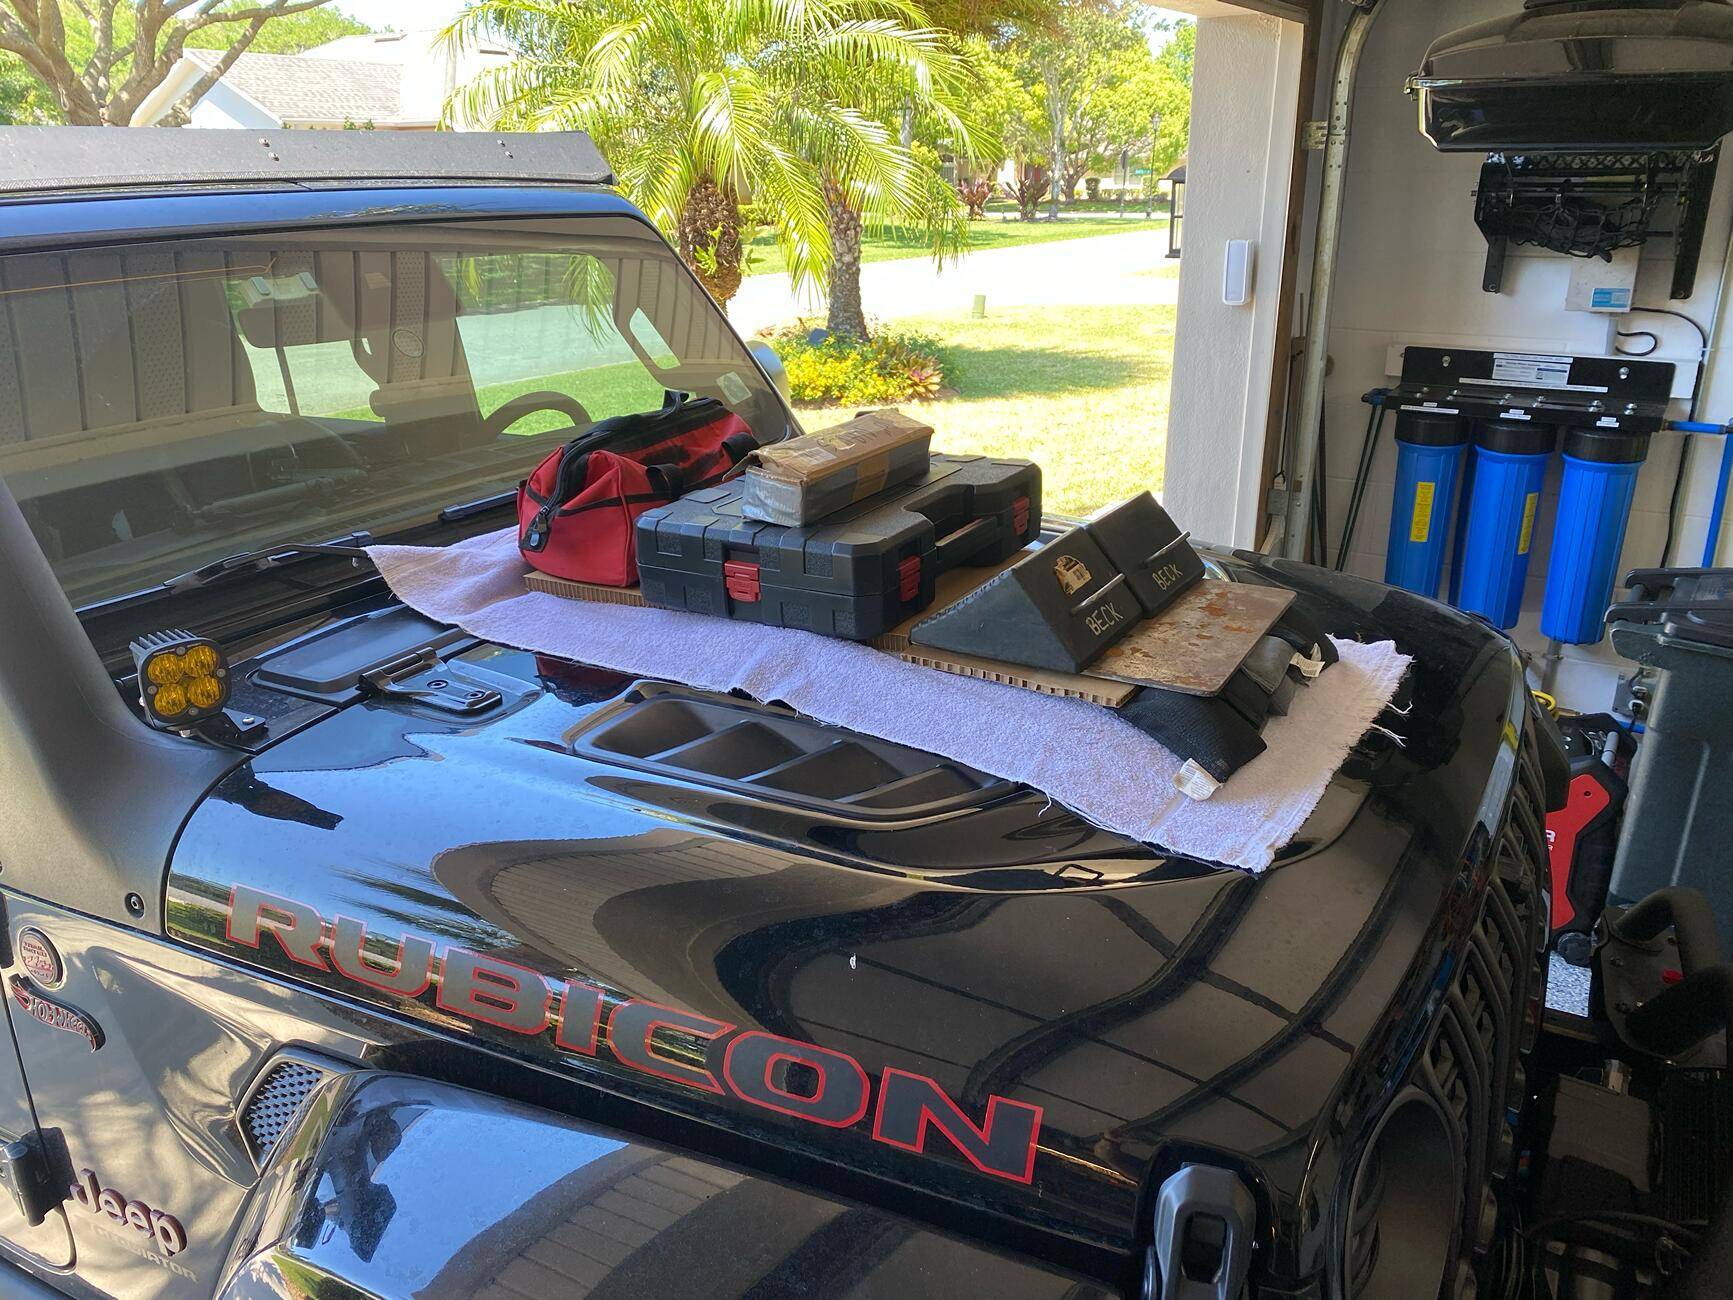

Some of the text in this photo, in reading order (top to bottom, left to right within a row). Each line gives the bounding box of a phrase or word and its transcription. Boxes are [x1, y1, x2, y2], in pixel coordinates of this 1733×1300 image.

[1152, 563, 1183, 591] BECK
[1085, 601, 1124, 636] BECK
[225, 883, 1044, 1185] RUBICON
[70, 1168, 188, 1257] Jeep
[90, 1222, 199, 1284] IATOR
